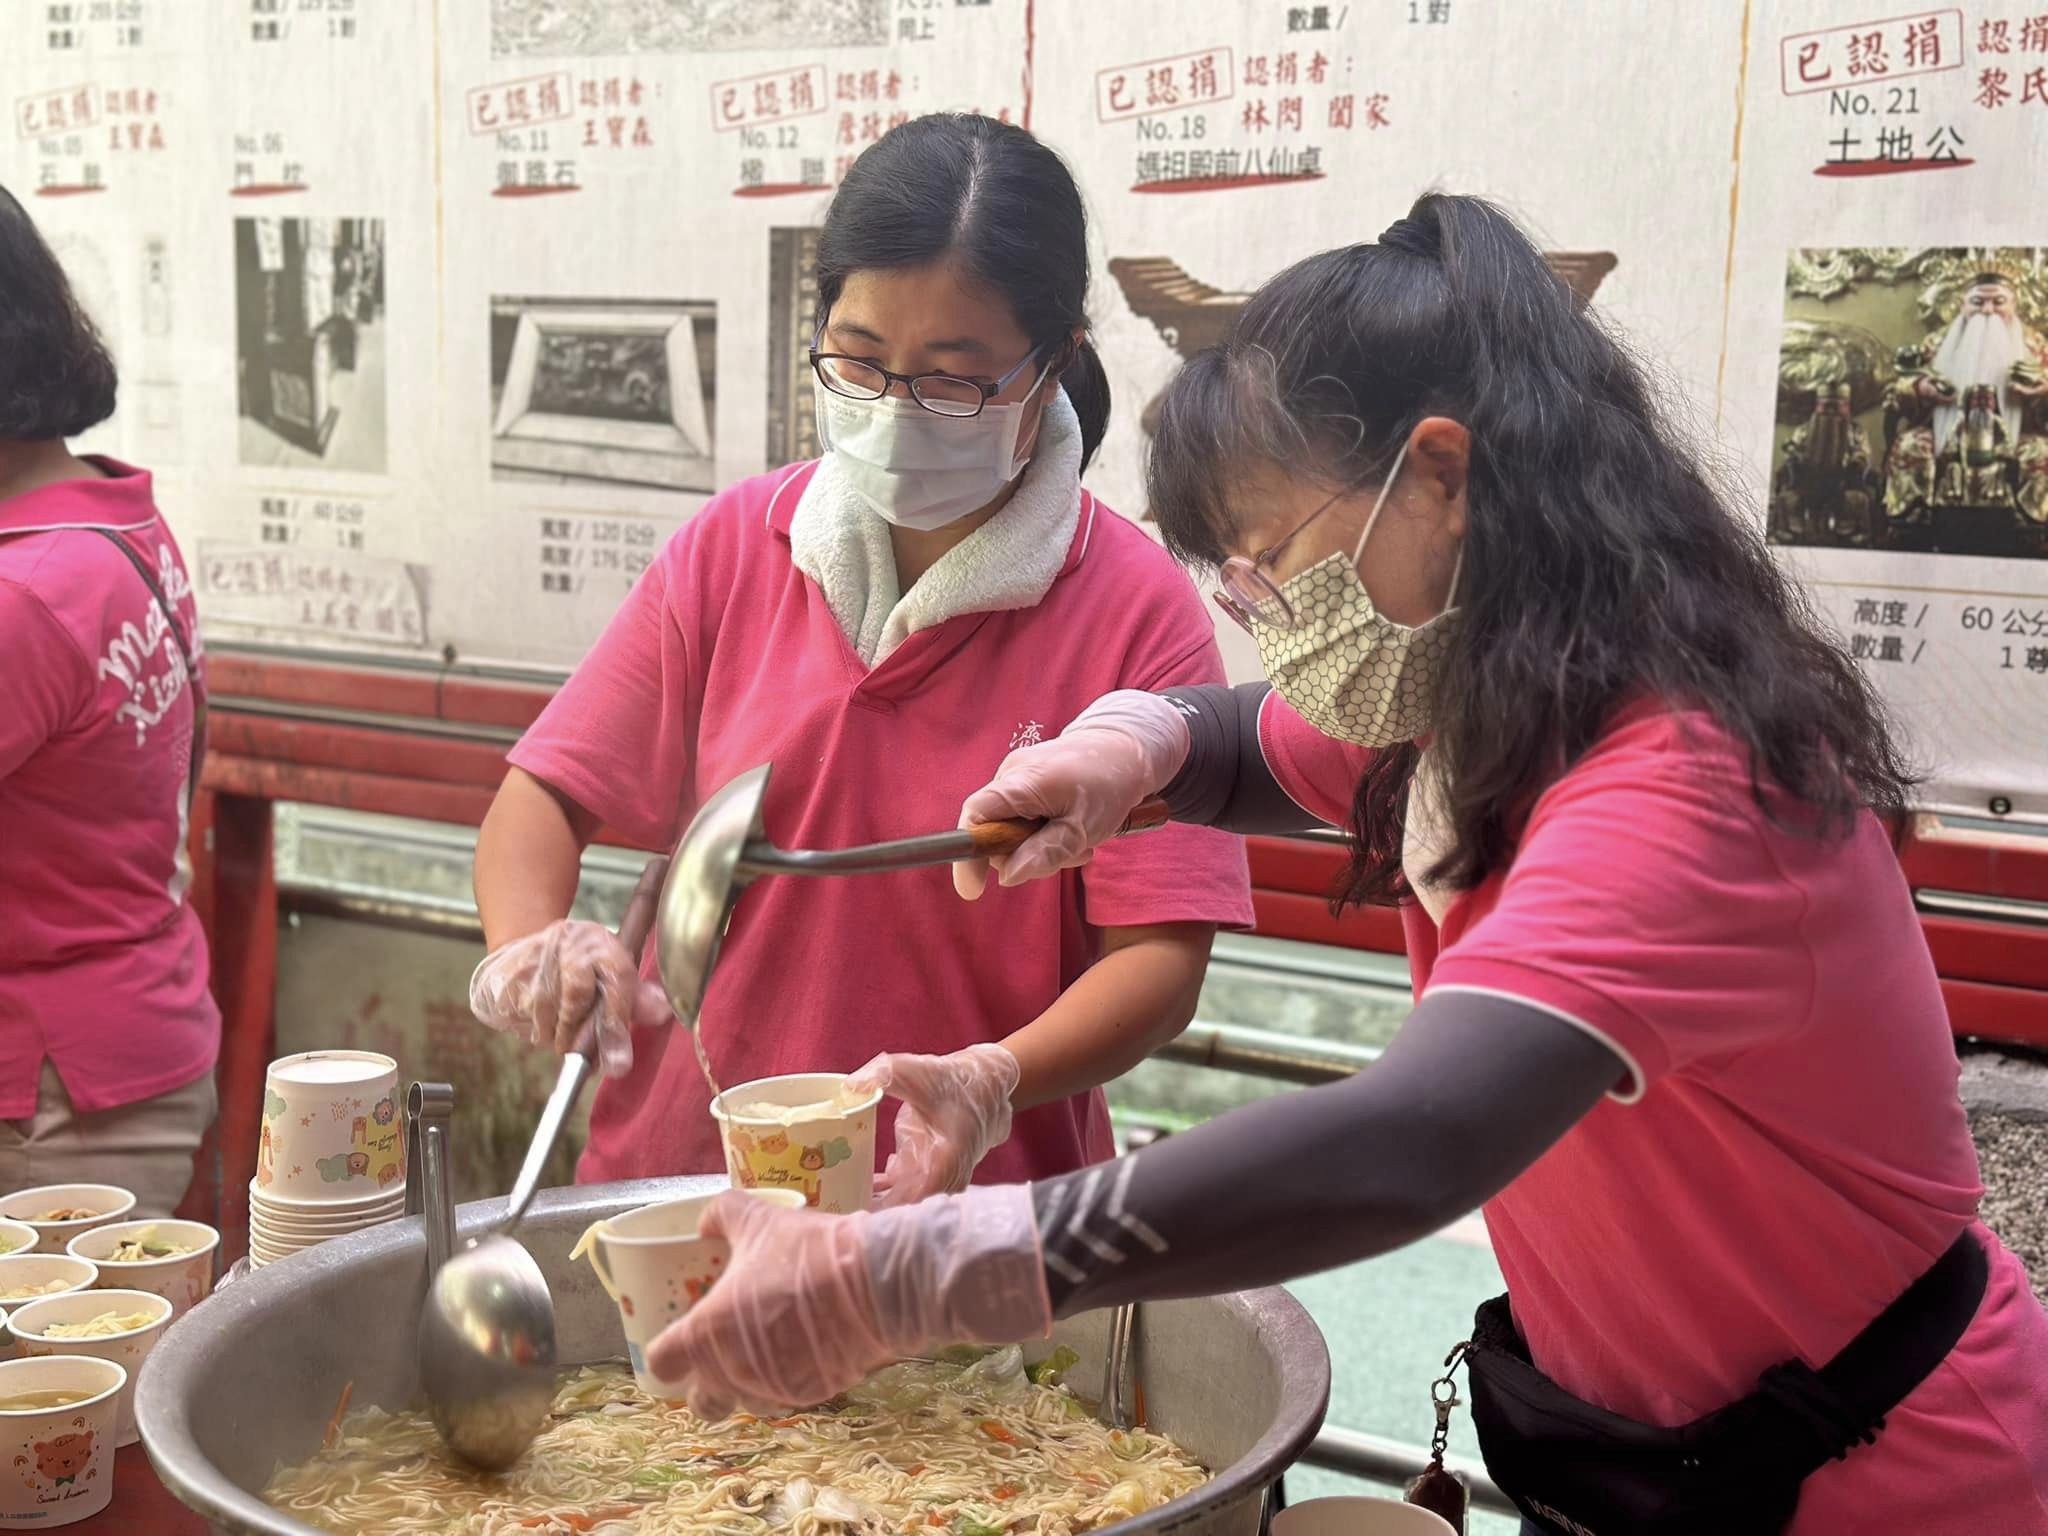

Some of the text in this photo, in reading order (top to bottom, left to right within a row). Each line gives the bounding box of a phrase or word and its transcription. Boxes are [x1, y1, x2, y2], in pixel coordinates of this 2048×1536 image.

[1798, 17, 1942, 83] 已認捐
[722, 72, 813, 121] 已認捐
[1109, 55, 1218, 113] 已認捐
[1830, 87, 1919, 115] No. 21
[1180, 115, 1206, 139] 18
[1825, 125, 1964, 163] 土地公
[1961, 606, 1993, 631] 60
[2000, 645, 2014, 669] 1
